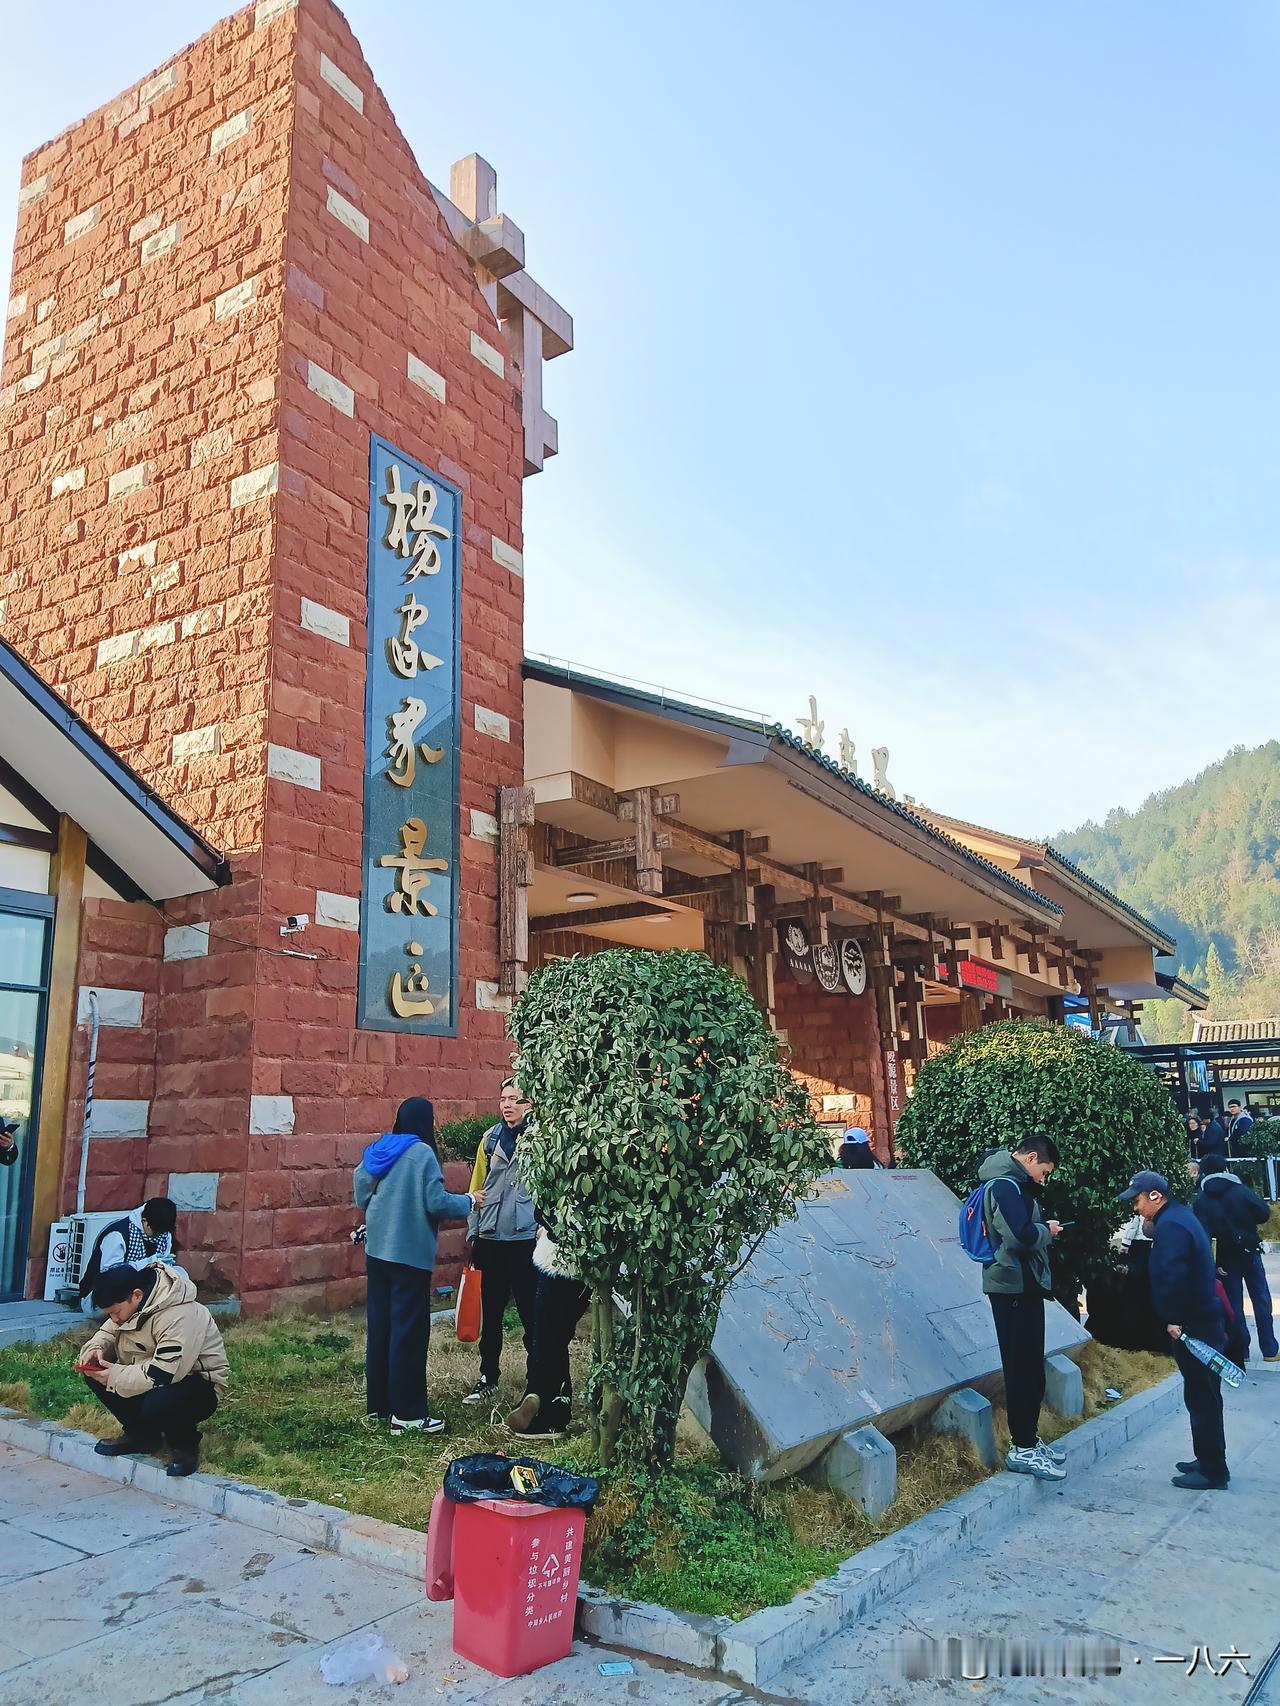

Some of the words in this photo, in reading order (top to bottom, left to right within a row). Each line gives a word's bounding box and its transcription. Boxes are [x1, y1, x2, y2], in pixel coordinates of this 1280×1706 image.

[525, 1538, 541, 1617] 参与垃圾分类
[560, 1527, 575, 1604] 共建美丽乡村
